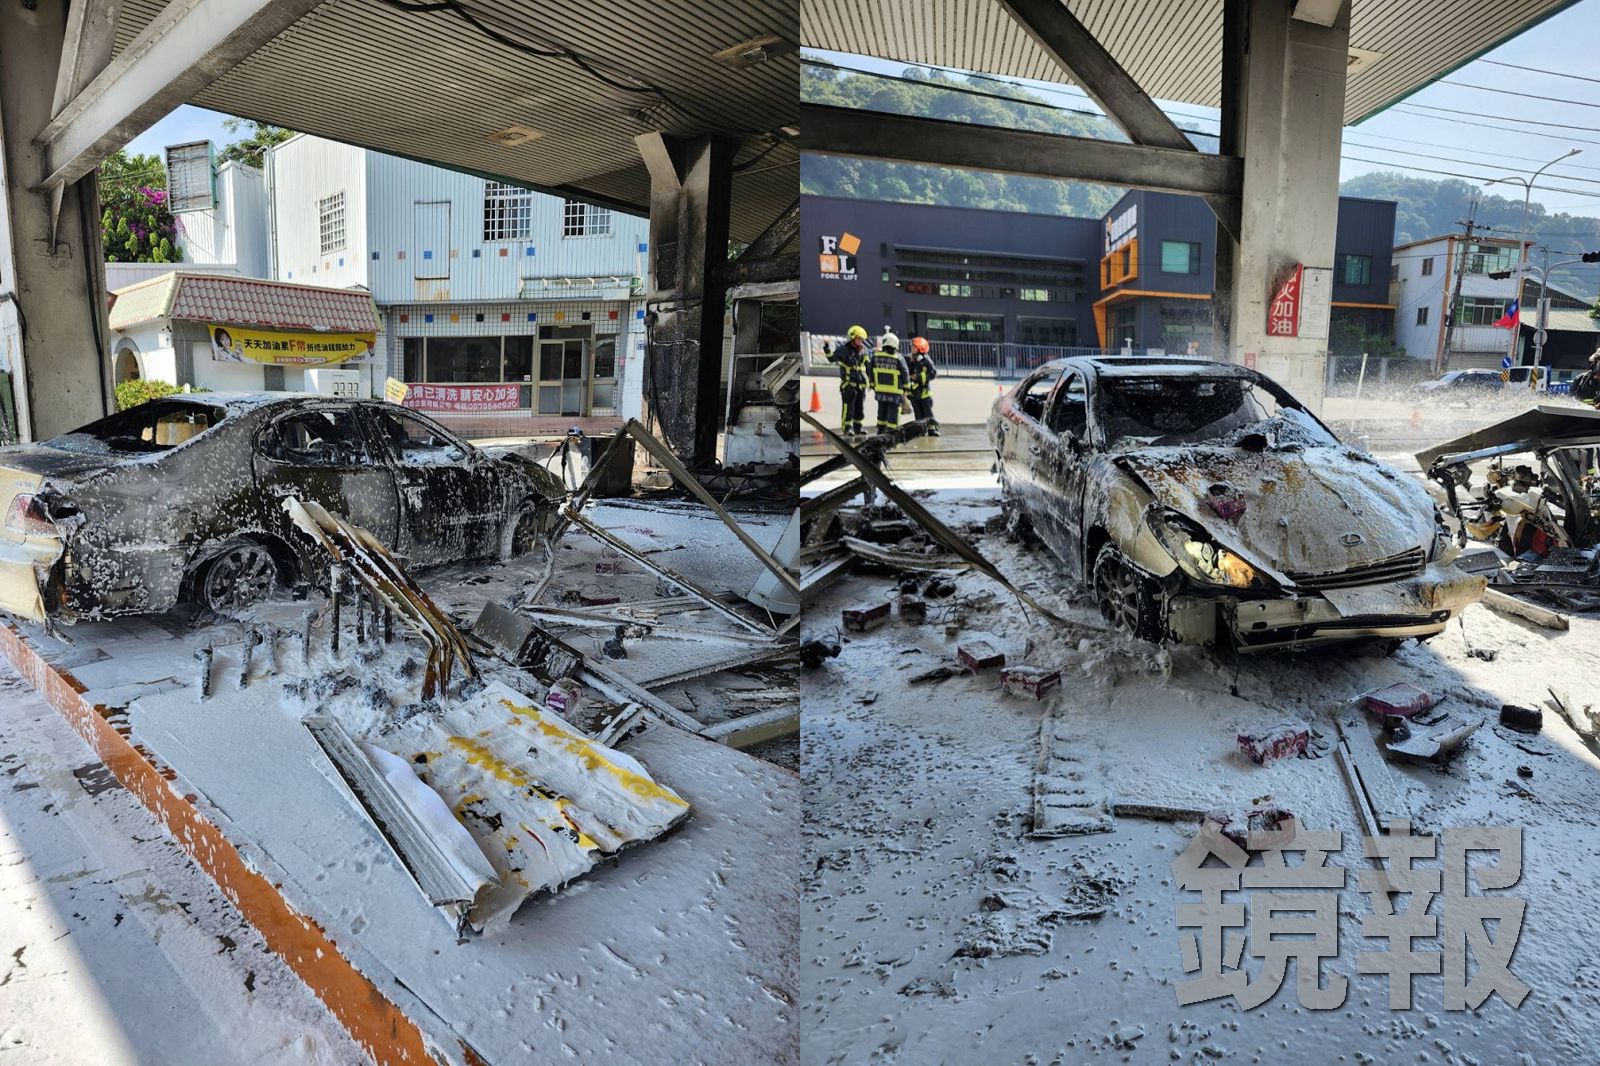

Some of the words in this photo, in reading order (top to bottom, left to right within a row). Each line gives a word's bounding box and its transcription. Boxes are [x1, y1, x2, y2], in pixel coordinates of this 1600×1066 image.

[839, 255, 855, 274] L
[1271, 271, 1298, 335] 火加油
[460, 387, 518, 401] 請安心加油
